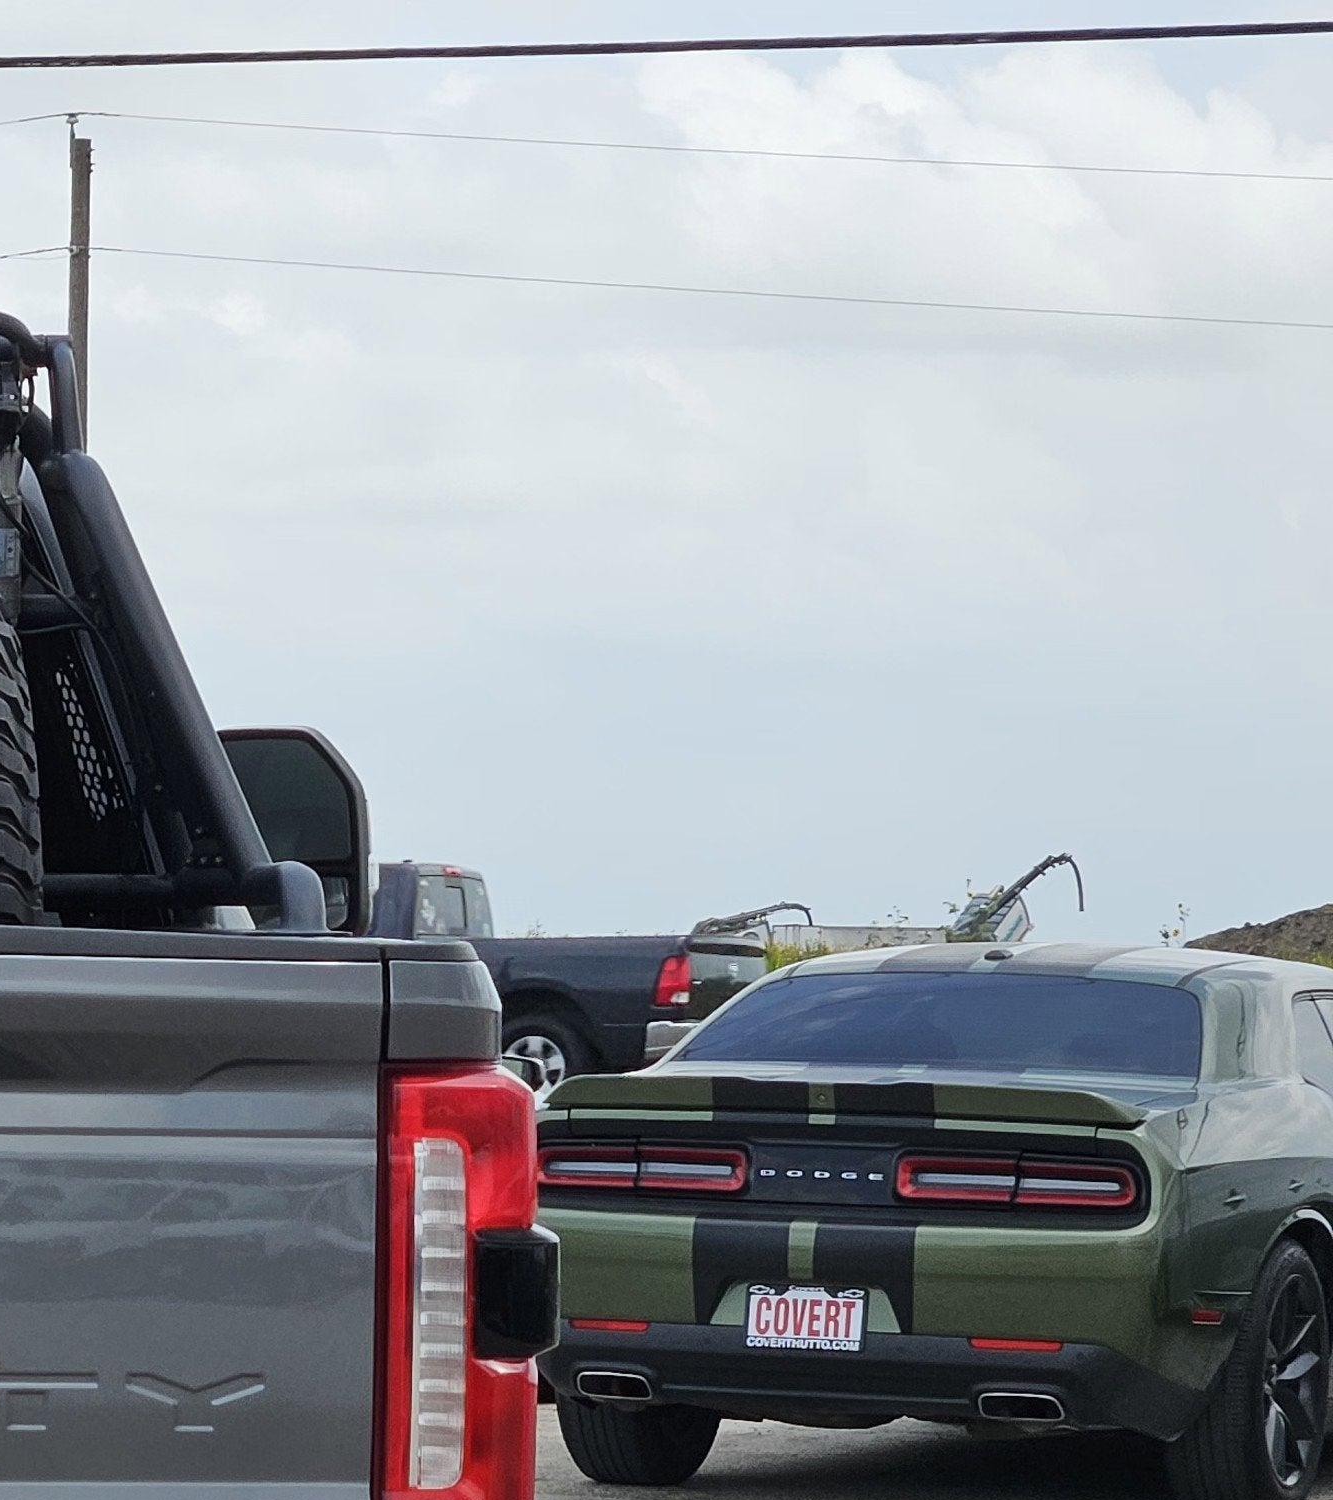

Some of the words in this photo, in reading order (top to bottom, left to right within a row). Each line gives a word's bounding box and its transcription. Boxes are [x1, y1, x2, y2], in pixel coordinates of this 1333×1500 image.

[760, 1169, 884, 1181] DODGE
[755, 1296, 856, 1338] COVERT
[746, 1336, 861, 1352] COVERTHUTTO.COM
